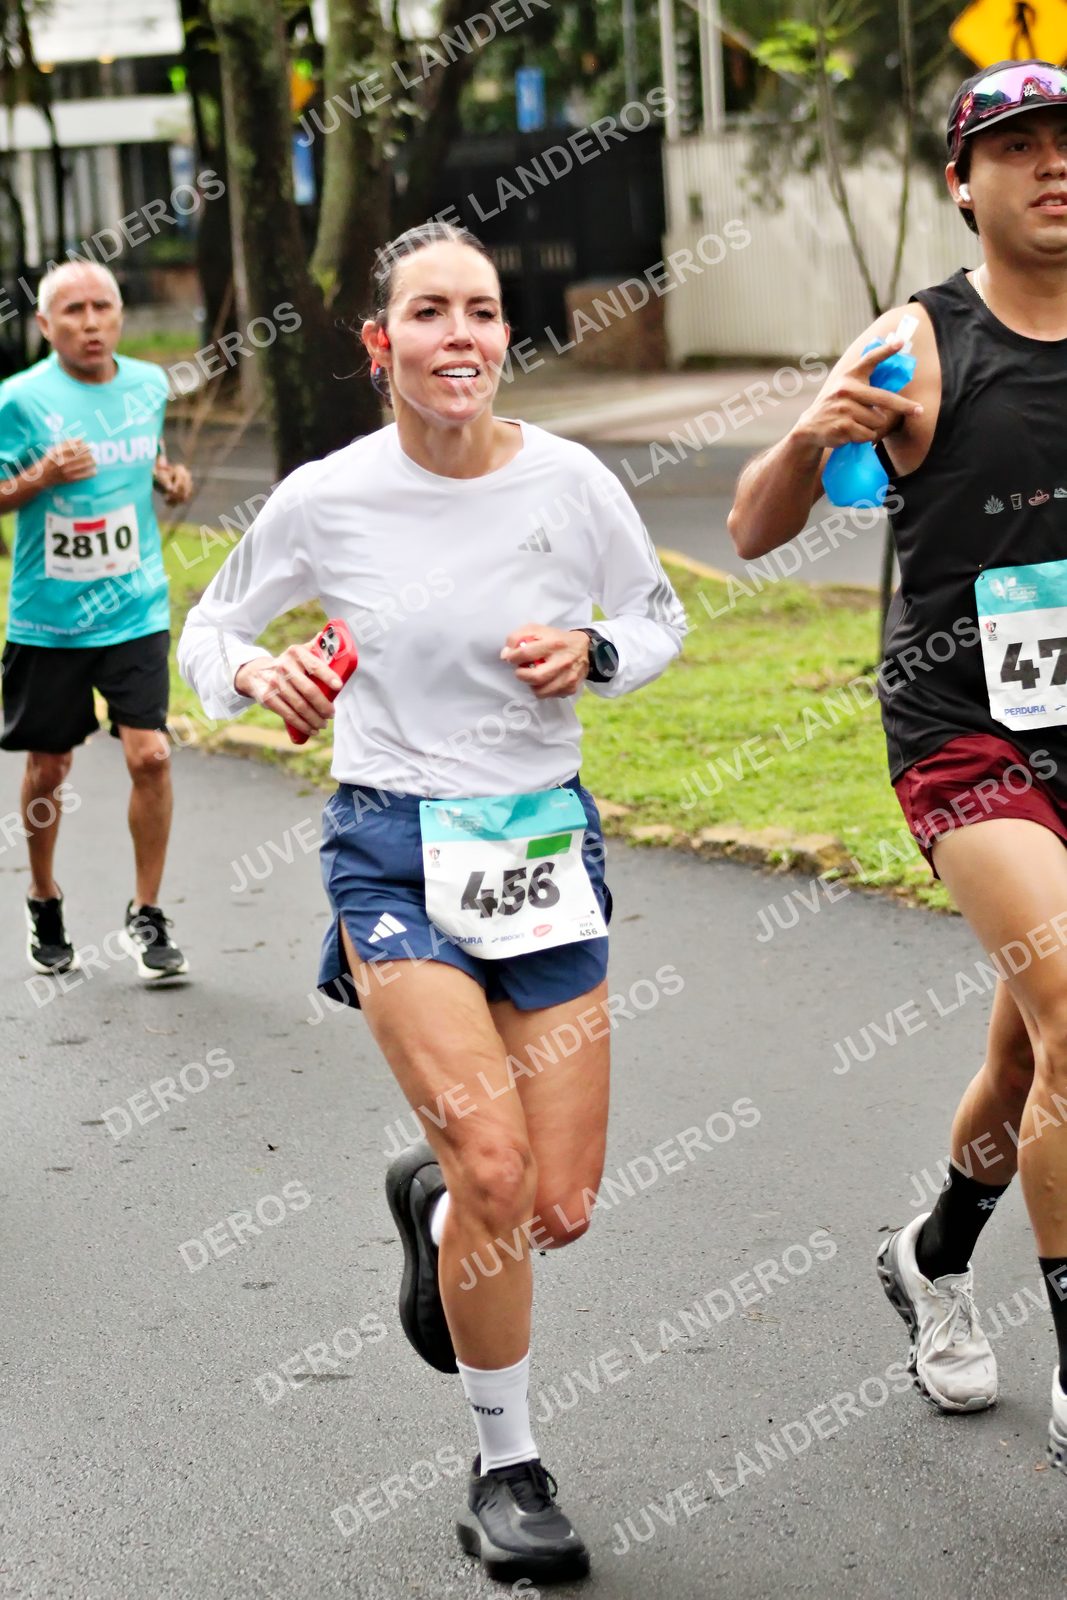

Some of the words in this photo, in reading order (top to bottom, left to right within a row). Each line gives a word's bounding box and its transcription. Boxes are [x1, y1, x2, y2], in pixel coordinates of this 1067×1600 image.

[52, 525, 132, 559] 2810
[1004, 705, 1046, 716] PERDURA
[461, 861, 560, 919] 456
[579, 928, 598, 936] 456
